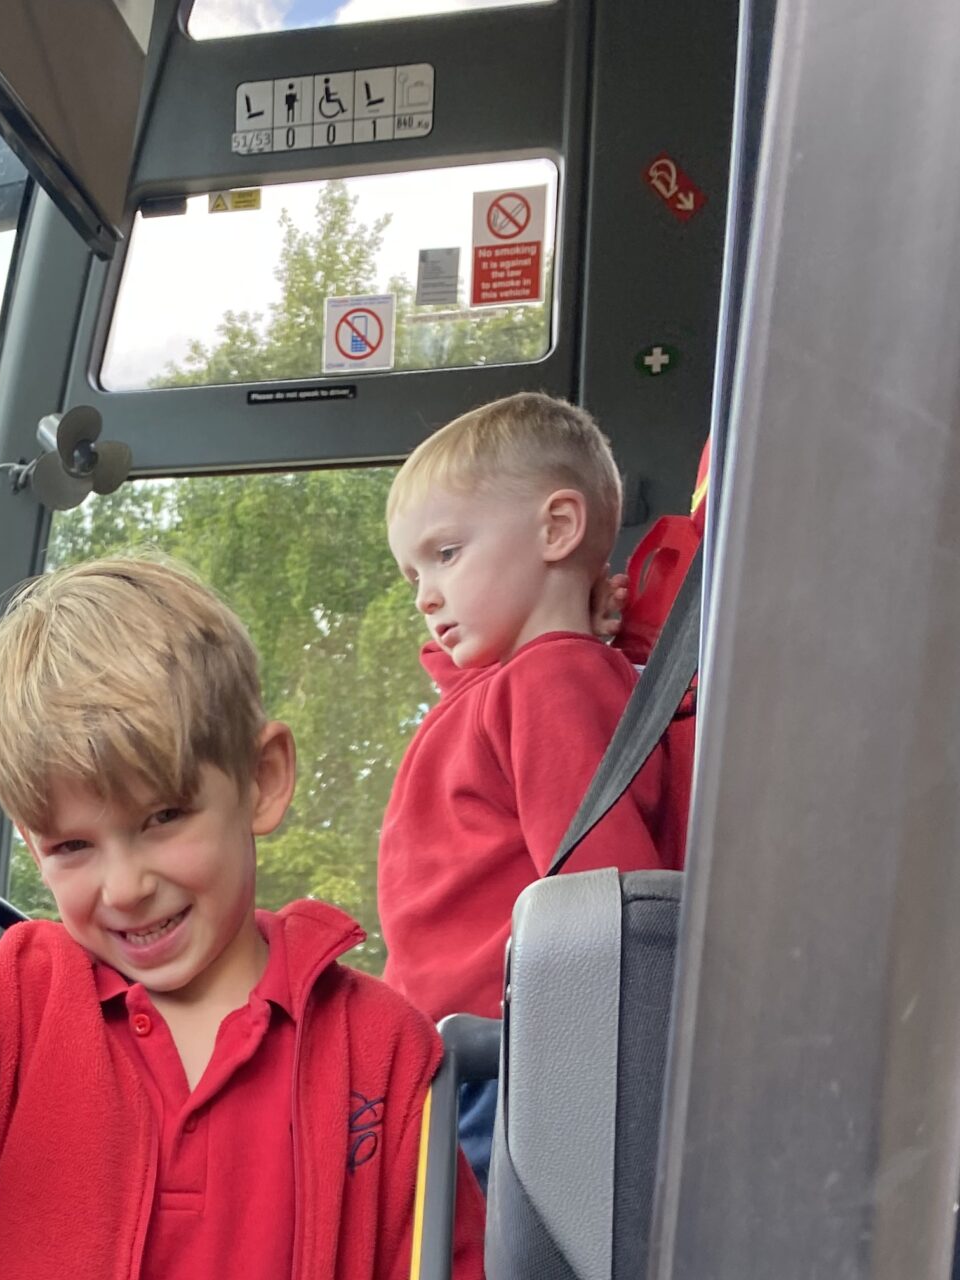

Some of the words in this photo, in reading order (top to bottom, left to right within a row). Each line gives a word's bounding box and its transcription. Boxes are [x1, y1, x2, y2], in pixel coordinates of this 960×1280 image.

[478, 248, 493, 258] No
[494, 245, 537, 256] smoking
[499, 258, 532, 269] against
[491, 270, 505, 278] the
[506, 270, 522, 278] law
[481, 281, 491, 290] to
[492, 279, 521, 289] smoke
[522, 278, 532, 286] in
[480, 291, 497, 299] this
[499, 288, 531, 298] vehicle
